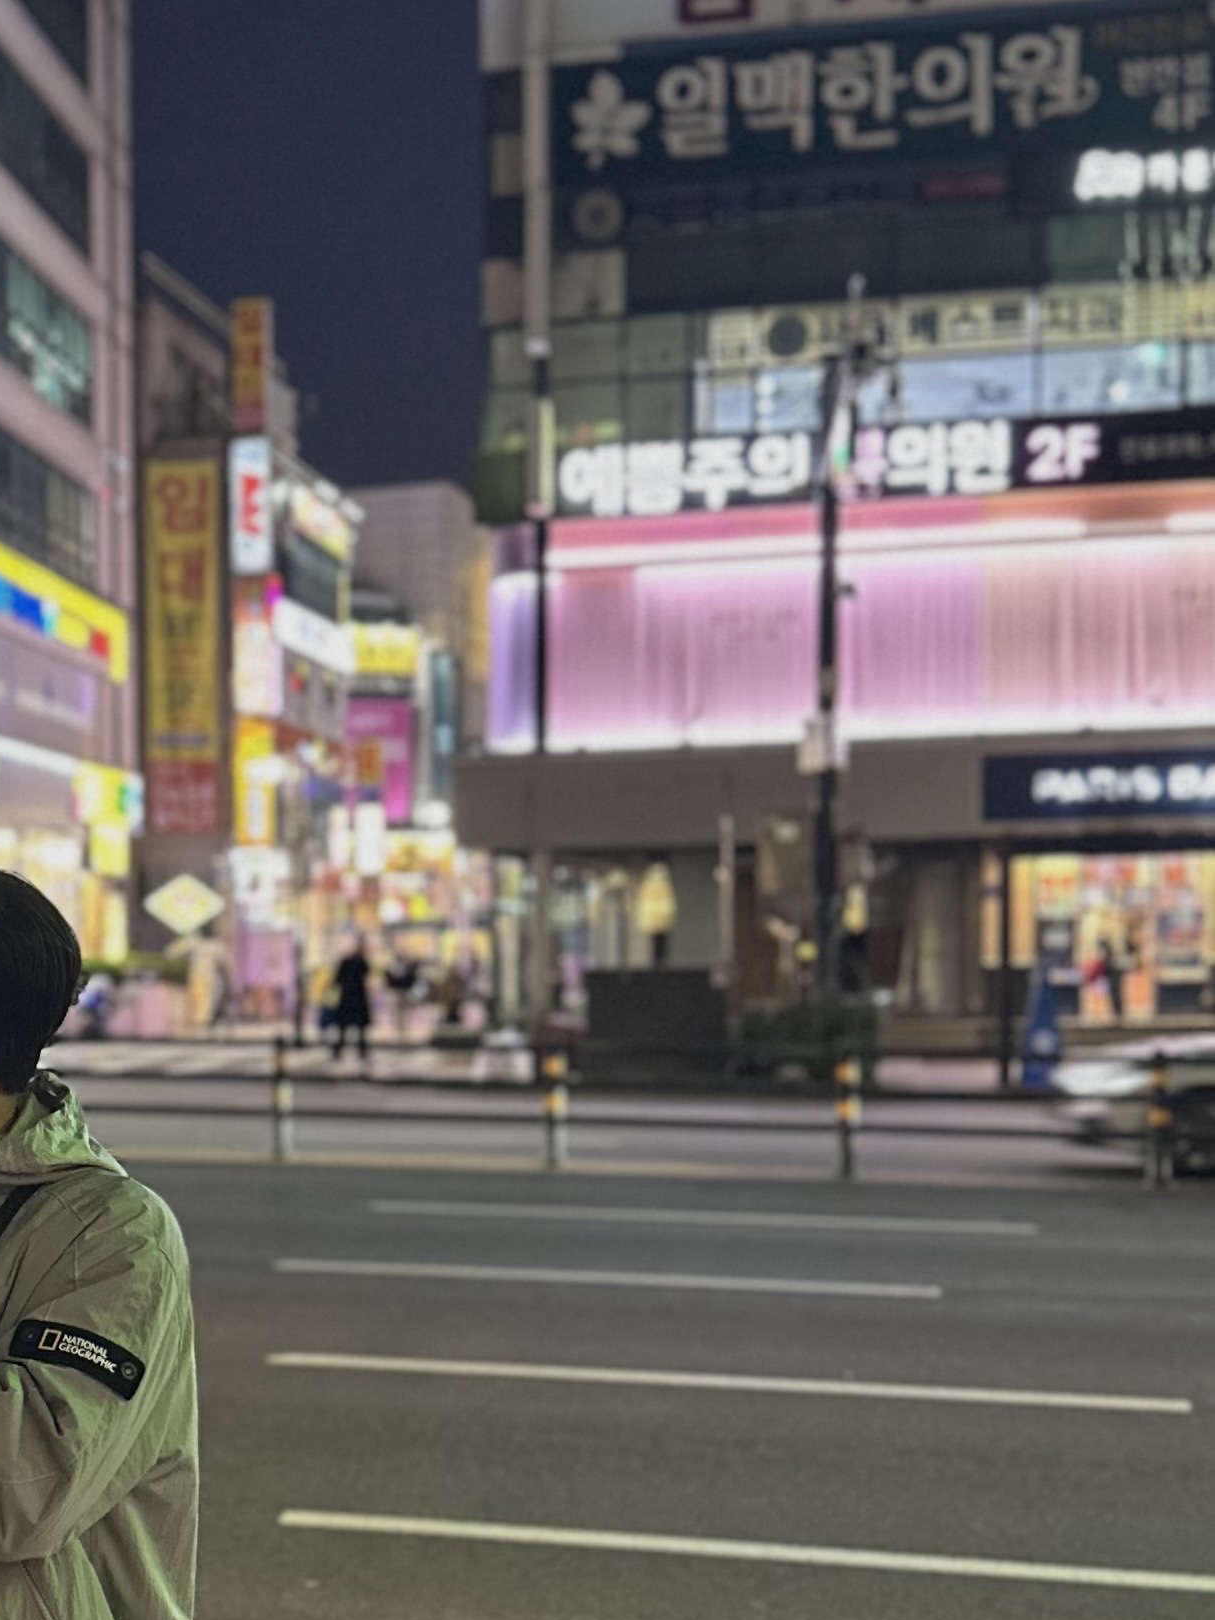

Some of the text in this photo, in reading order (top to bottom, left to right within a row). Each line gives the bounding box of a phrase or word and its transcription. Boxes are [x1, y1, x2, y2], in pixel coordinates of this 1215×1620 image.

[656, 26, 1099, 158] 일맥한의원
[1026, 424, 1101, 482] 2F
[153, 474, 212, 603] 임대
[1032, 764, 1163, 804] PARIS
[58, 1342, 118, 1374] GEOGRAPHIC
[62, 1333, 108, 1359] NATIONAL
